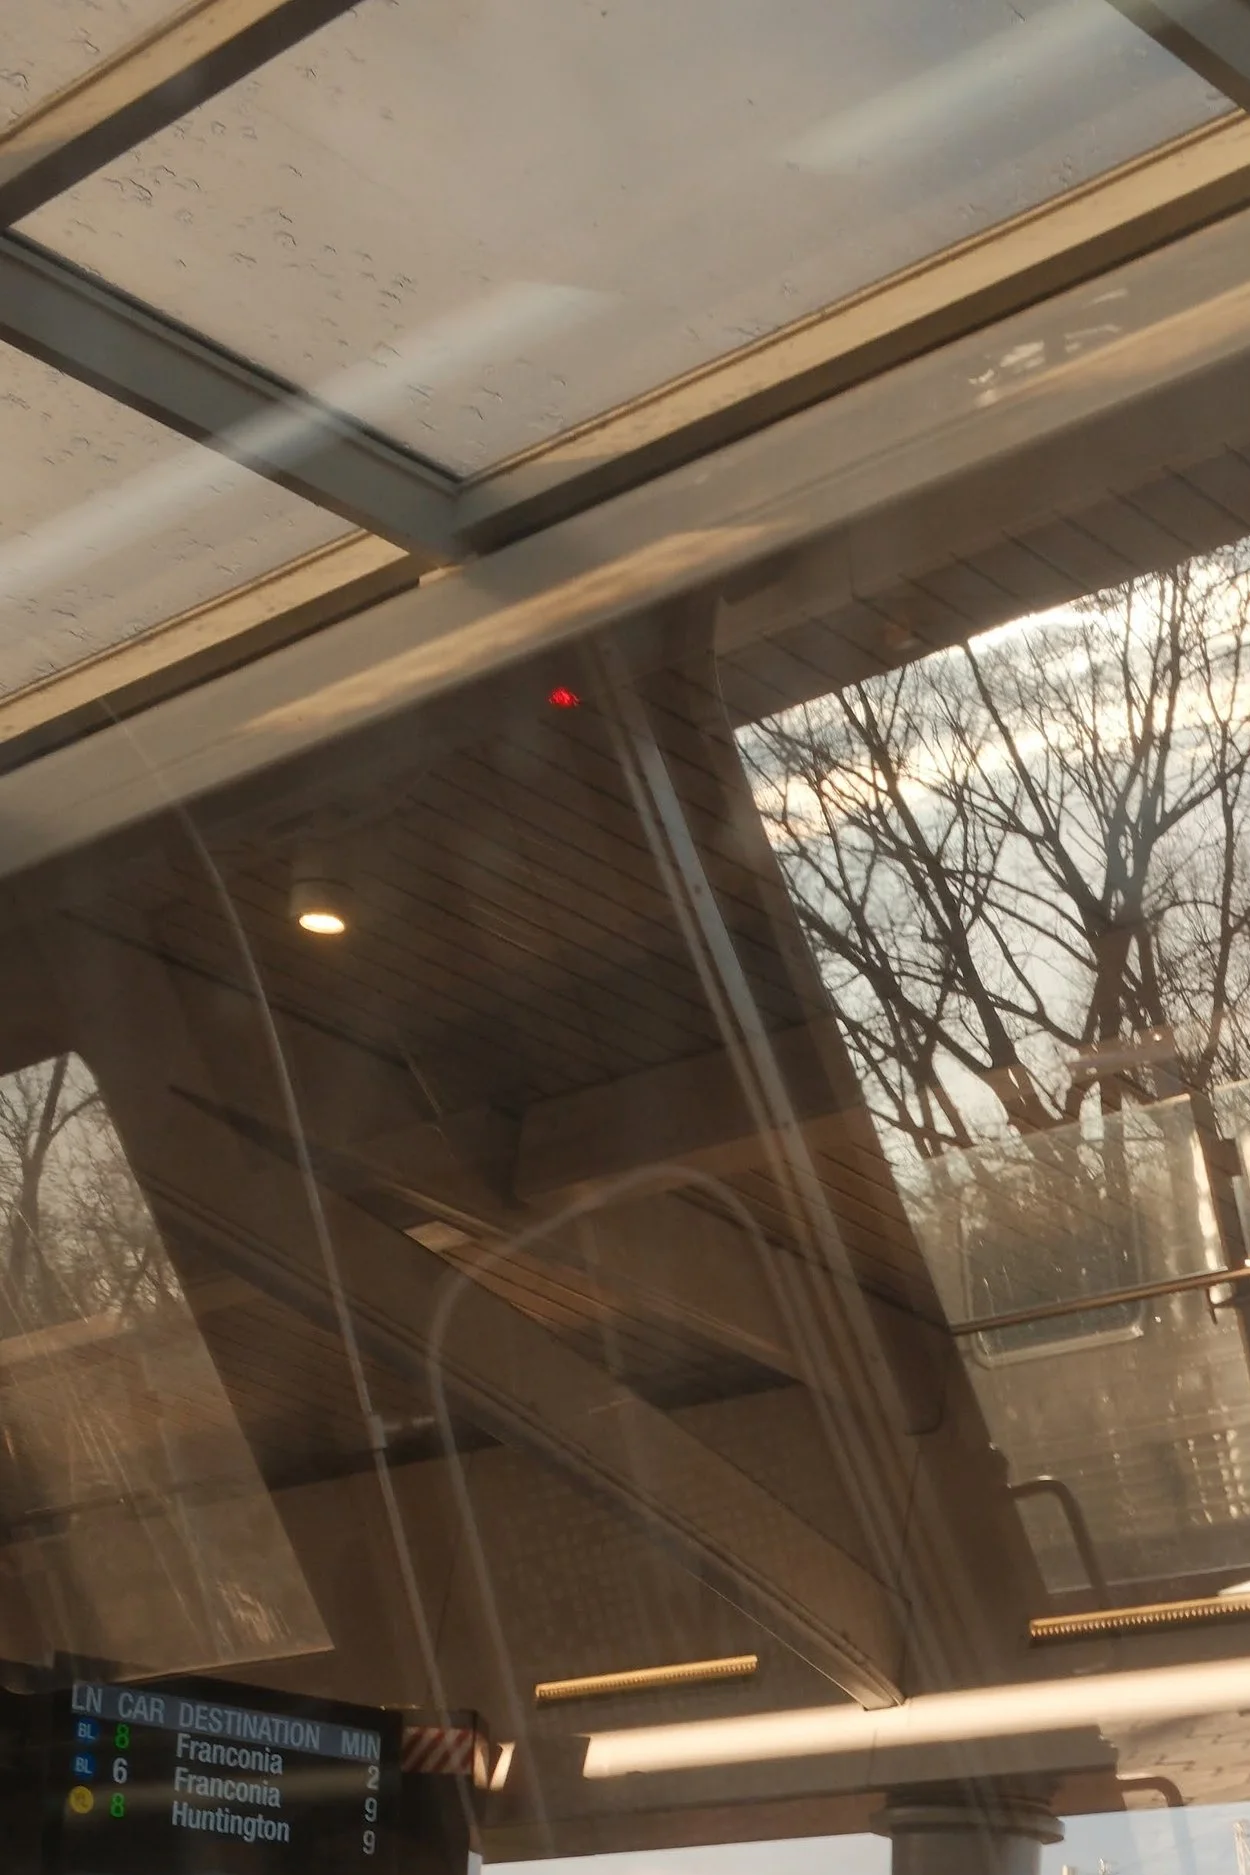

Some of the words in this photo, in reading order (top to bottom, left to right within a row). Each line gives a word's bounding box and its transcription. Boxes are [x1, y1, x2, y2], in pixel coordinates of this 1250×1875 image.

[72, 1684, 101, 1714] LN
[118, 1693, 164, 1725] CAR
[179, 1704, 320, 1751] DESTINATION
[341, 1729, 380, 1760] MIN
[78, 1722, 95, 1740] BL
[115, 1723, 129, 1749] 8
[176, 1733, 283, 1776] Franconia
[366, 1765, 380, 1790] 2
[75, 1757, 93, 1775] BL
[112, 1757, 128, 1784] 6
[174, 1767, 282, 1808] Franconia
[364, 1798, 378, 1822] 9
[110, 1792, 125, 1818] 8
[172, 1800, 291, 1843] Huntington
[362, 1831, 376, 1855] 9
